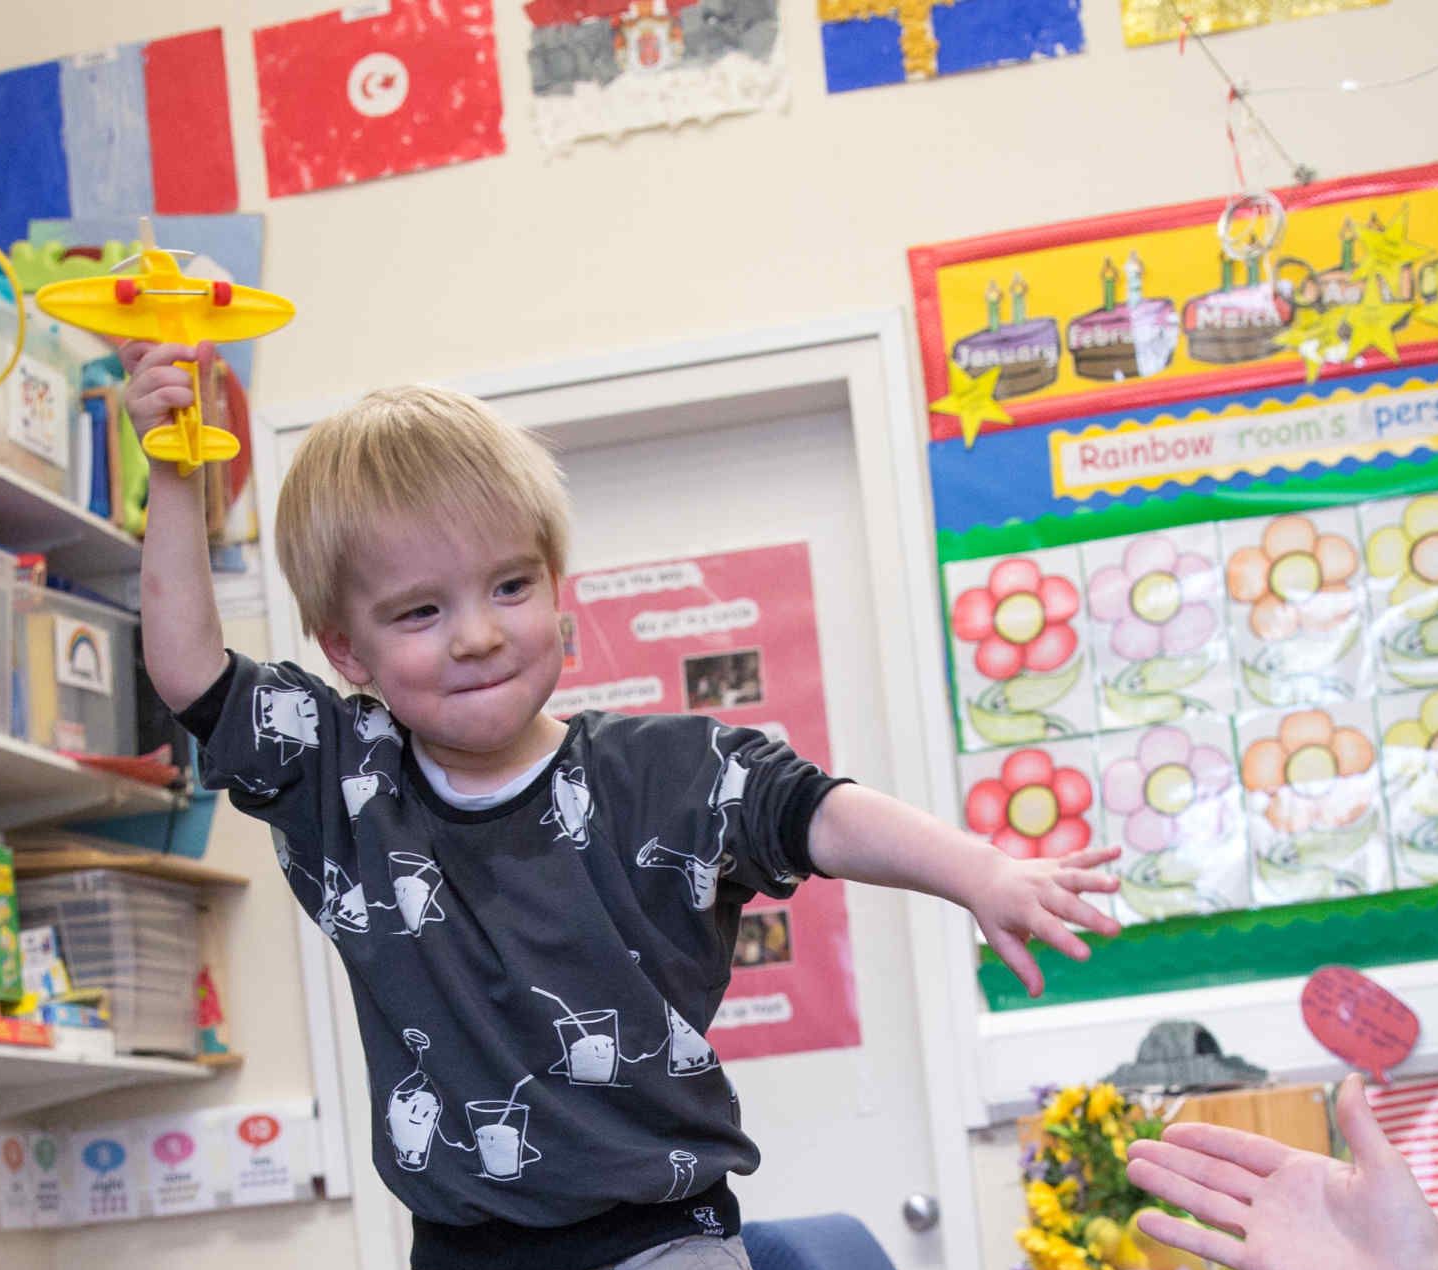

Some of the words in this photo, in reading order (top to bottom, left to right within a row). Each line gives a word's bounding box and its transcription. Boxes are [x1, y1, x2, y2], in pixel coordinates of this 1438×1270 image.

[1195, 305, 1280, 330] March
[1069, 318, 1169, 349] Februy
[958, 344, 1058, 370] January
[1077, 432, 1214, 472] Rainbow
[1237, 411, 1347, 450] room's
